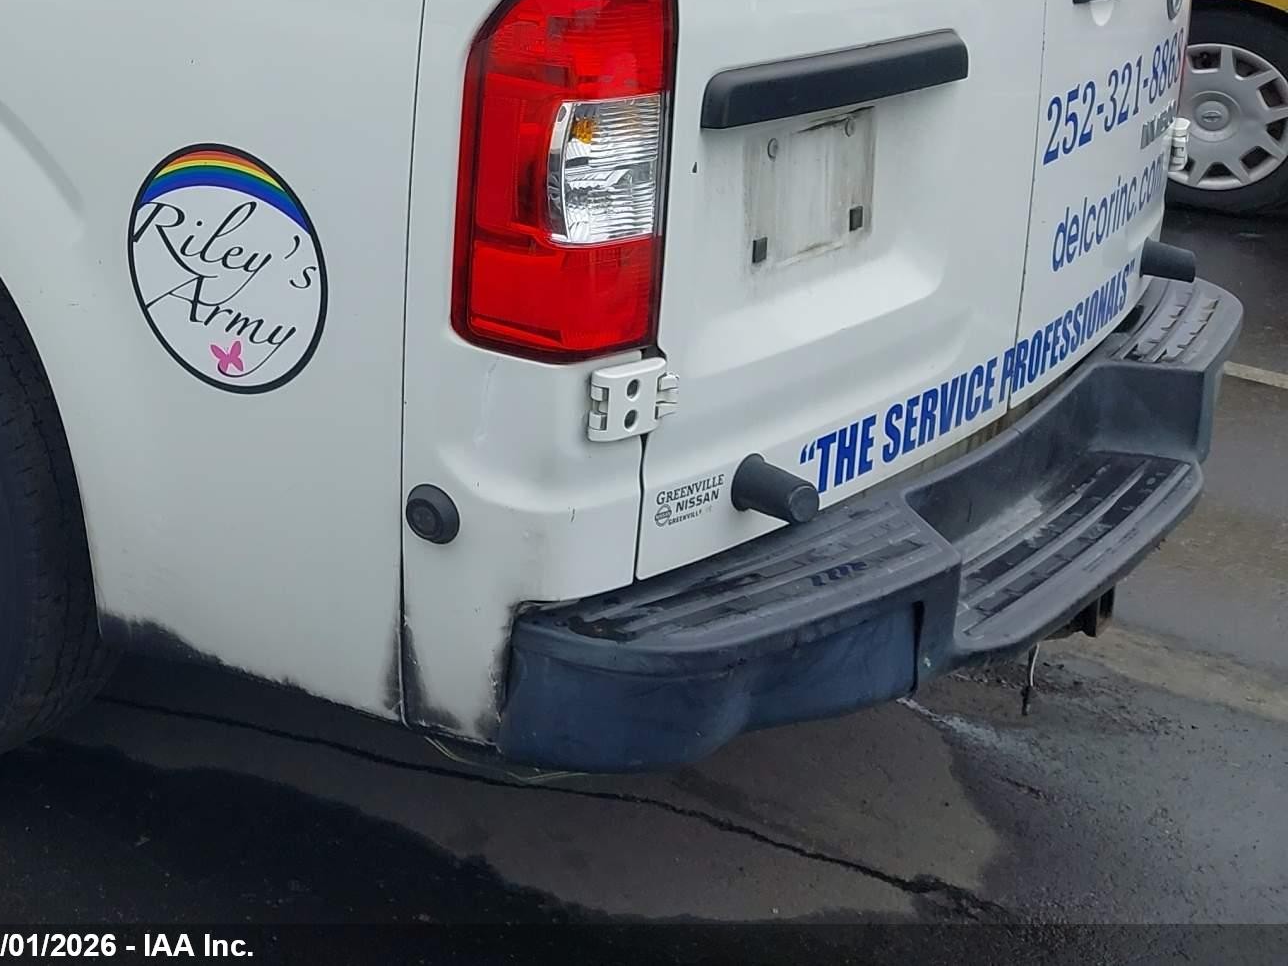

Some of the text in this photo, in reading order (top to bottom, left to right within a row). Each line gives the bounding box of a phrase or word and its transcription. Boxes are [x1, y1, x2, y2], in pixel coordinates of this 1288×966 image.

[133, 201, 317, 306] Riley's
[145, 276, 297, 378] Army
[881, 357, 998, 463] SERVICE
[656, 474, 725, 505] GREENVILLE
[676, 488, 720, 513] NISSAN
